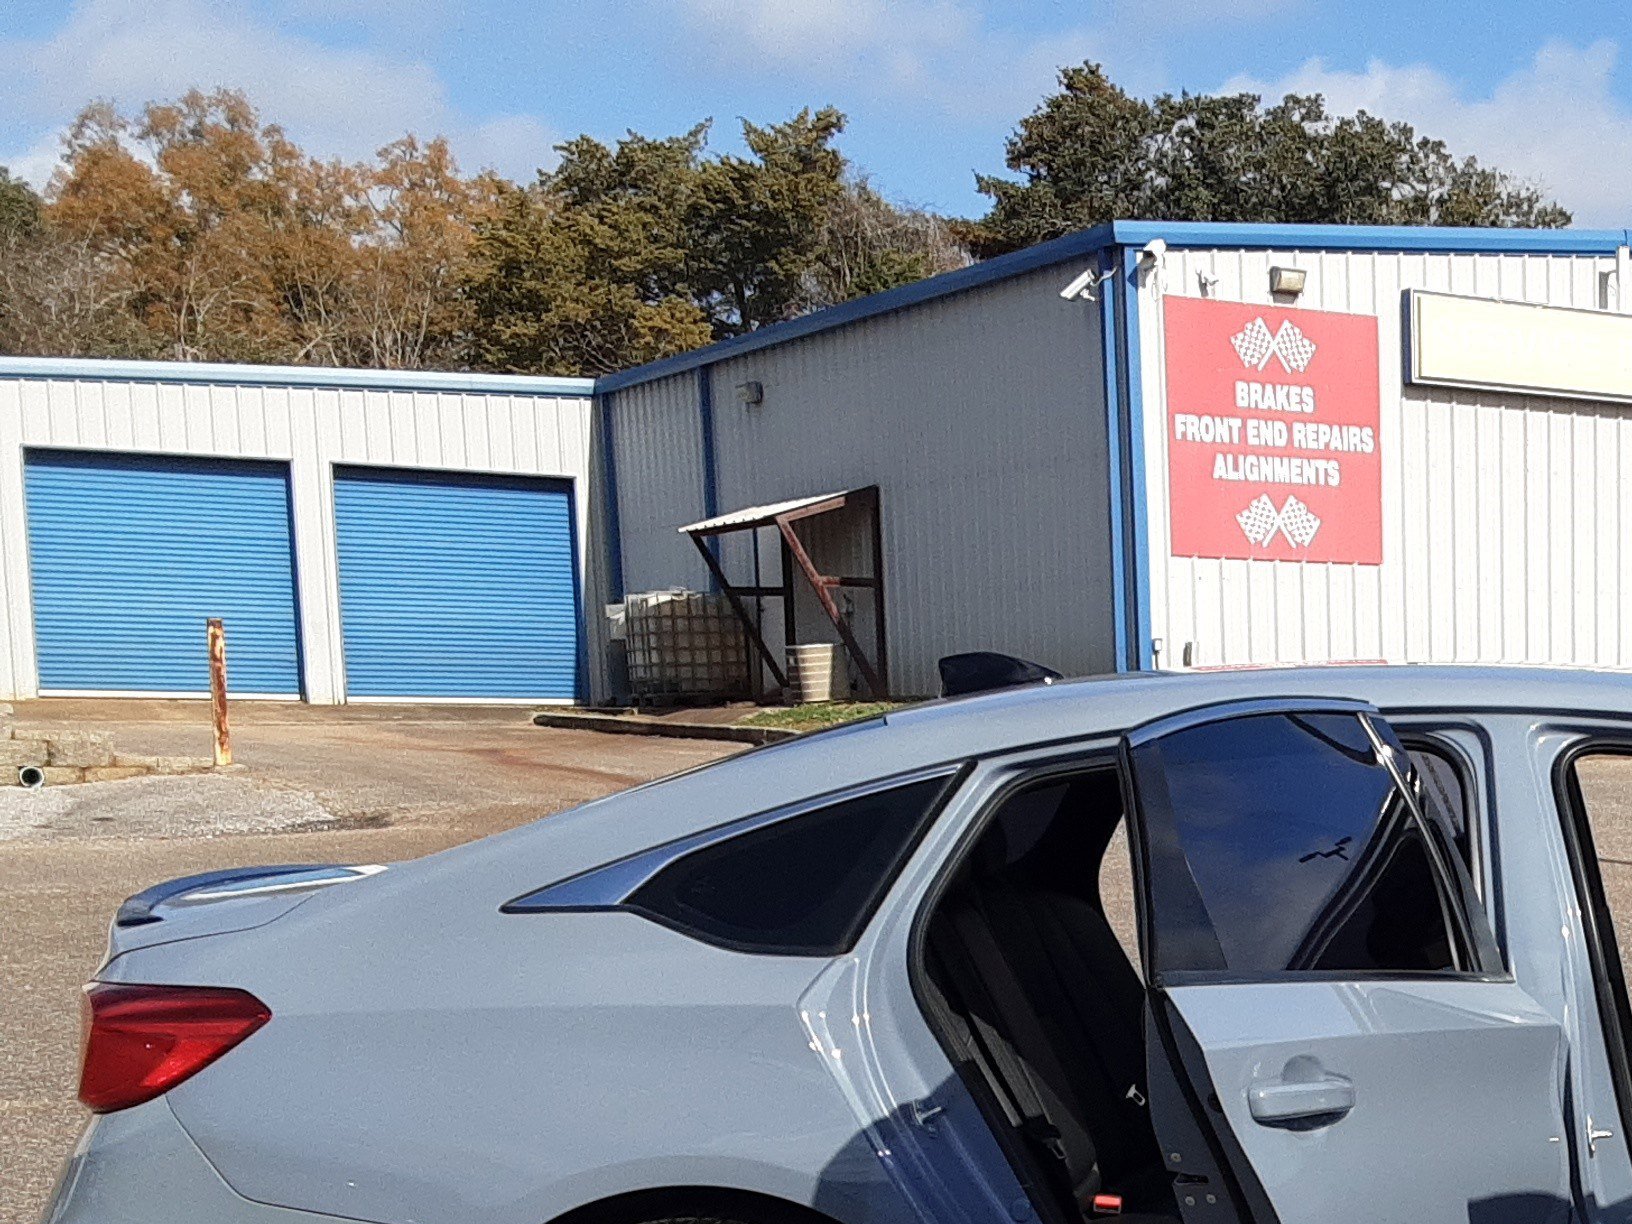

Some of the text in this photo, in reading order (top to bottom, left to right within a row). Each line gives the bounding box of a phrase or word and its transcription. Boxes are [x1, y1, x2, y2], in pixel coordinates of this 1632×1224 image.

[1235, 381, 1314, 413] BRAKES
[1174, 413, 1375, 454] FRONT END REPAIRS
[1212, 453, 1340, 487] ALIGNMENTS
